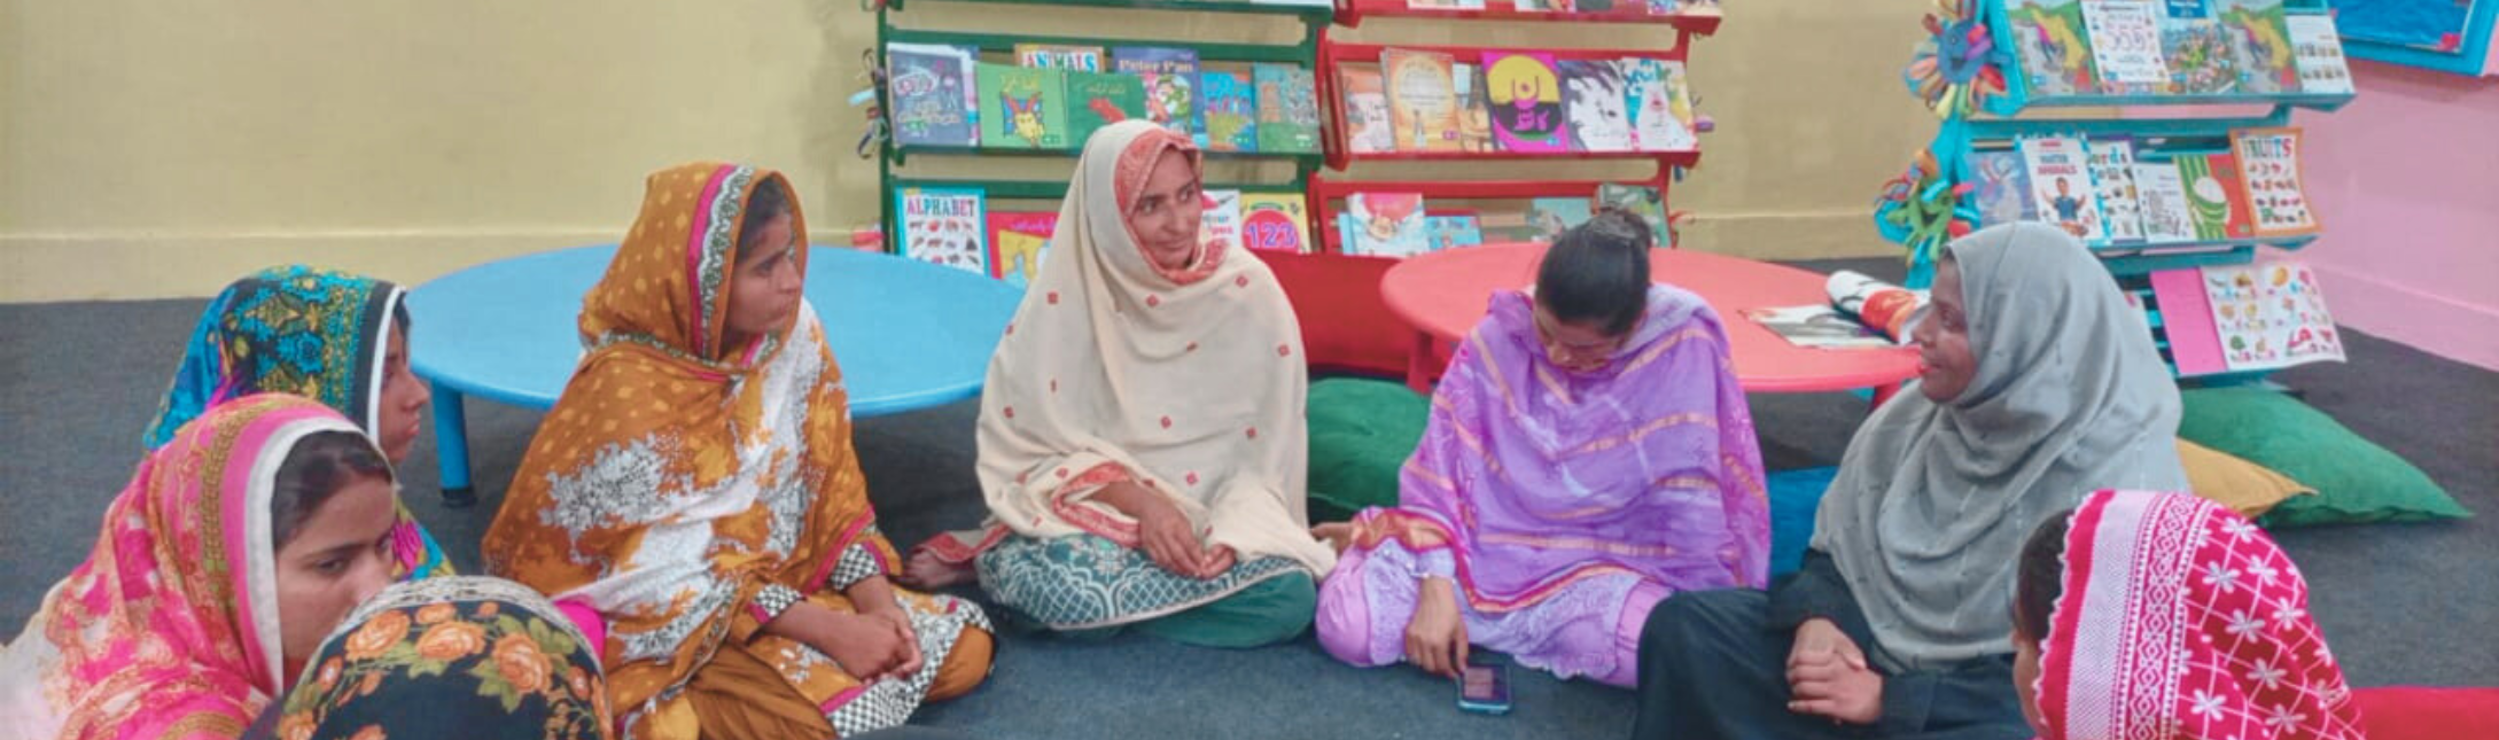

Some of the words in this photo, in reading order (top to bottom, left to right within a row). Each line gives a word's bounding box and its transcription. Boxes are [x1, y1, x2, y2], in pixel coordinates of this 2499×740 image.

[1118, 59, 1158, 72] Peter
[1163, 60, 1193, 73] Pan
[2244, 138, 2293, 158] FRUITS
[907, 198, 975, 217] ALPHABET
[1245, 221, 1297, 249] 123
